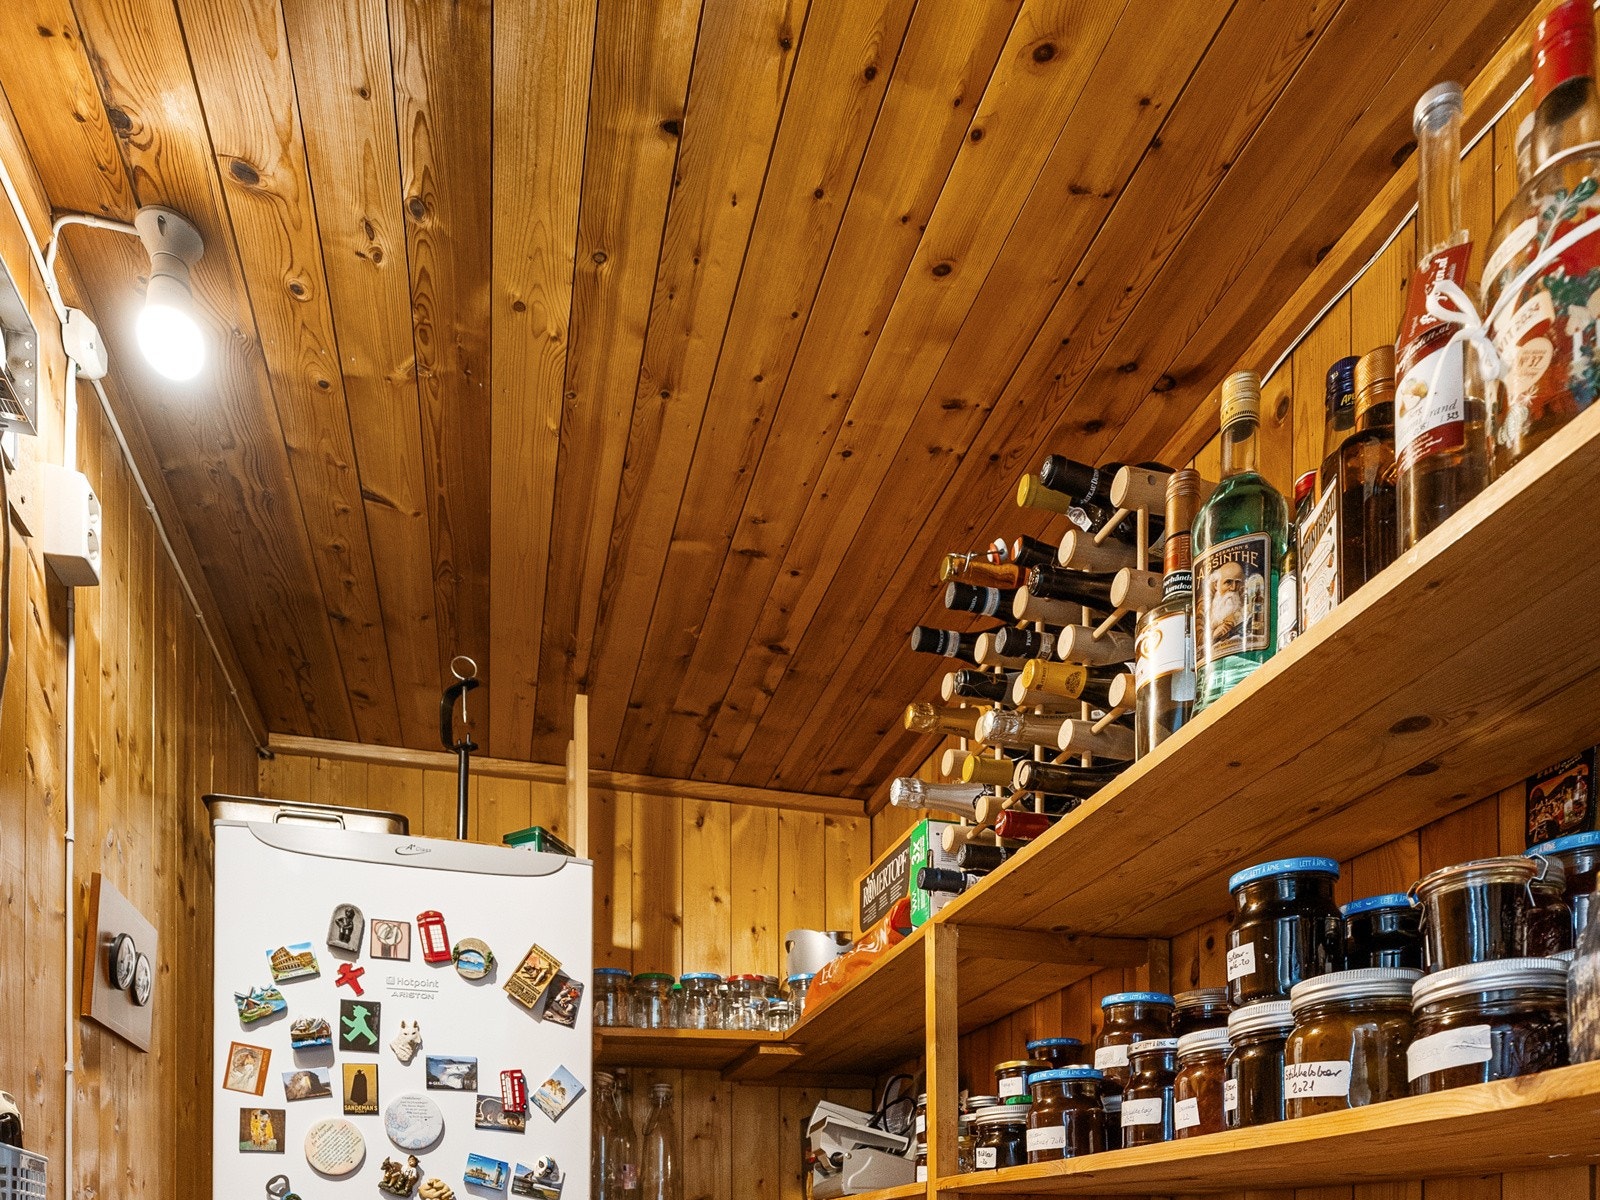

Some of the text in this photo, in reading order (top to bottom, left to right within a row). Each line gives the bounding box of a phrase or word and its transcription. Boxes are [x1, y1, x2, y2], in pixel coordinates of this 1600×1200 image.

[1196, 551, 1259, 590] ABSINTHE
[397, 977, 439, 988] Hotpoint
[391, 991, 435, 1000] ARISTON
[344, 1104, 378, 1112] SANDEMAN'S
